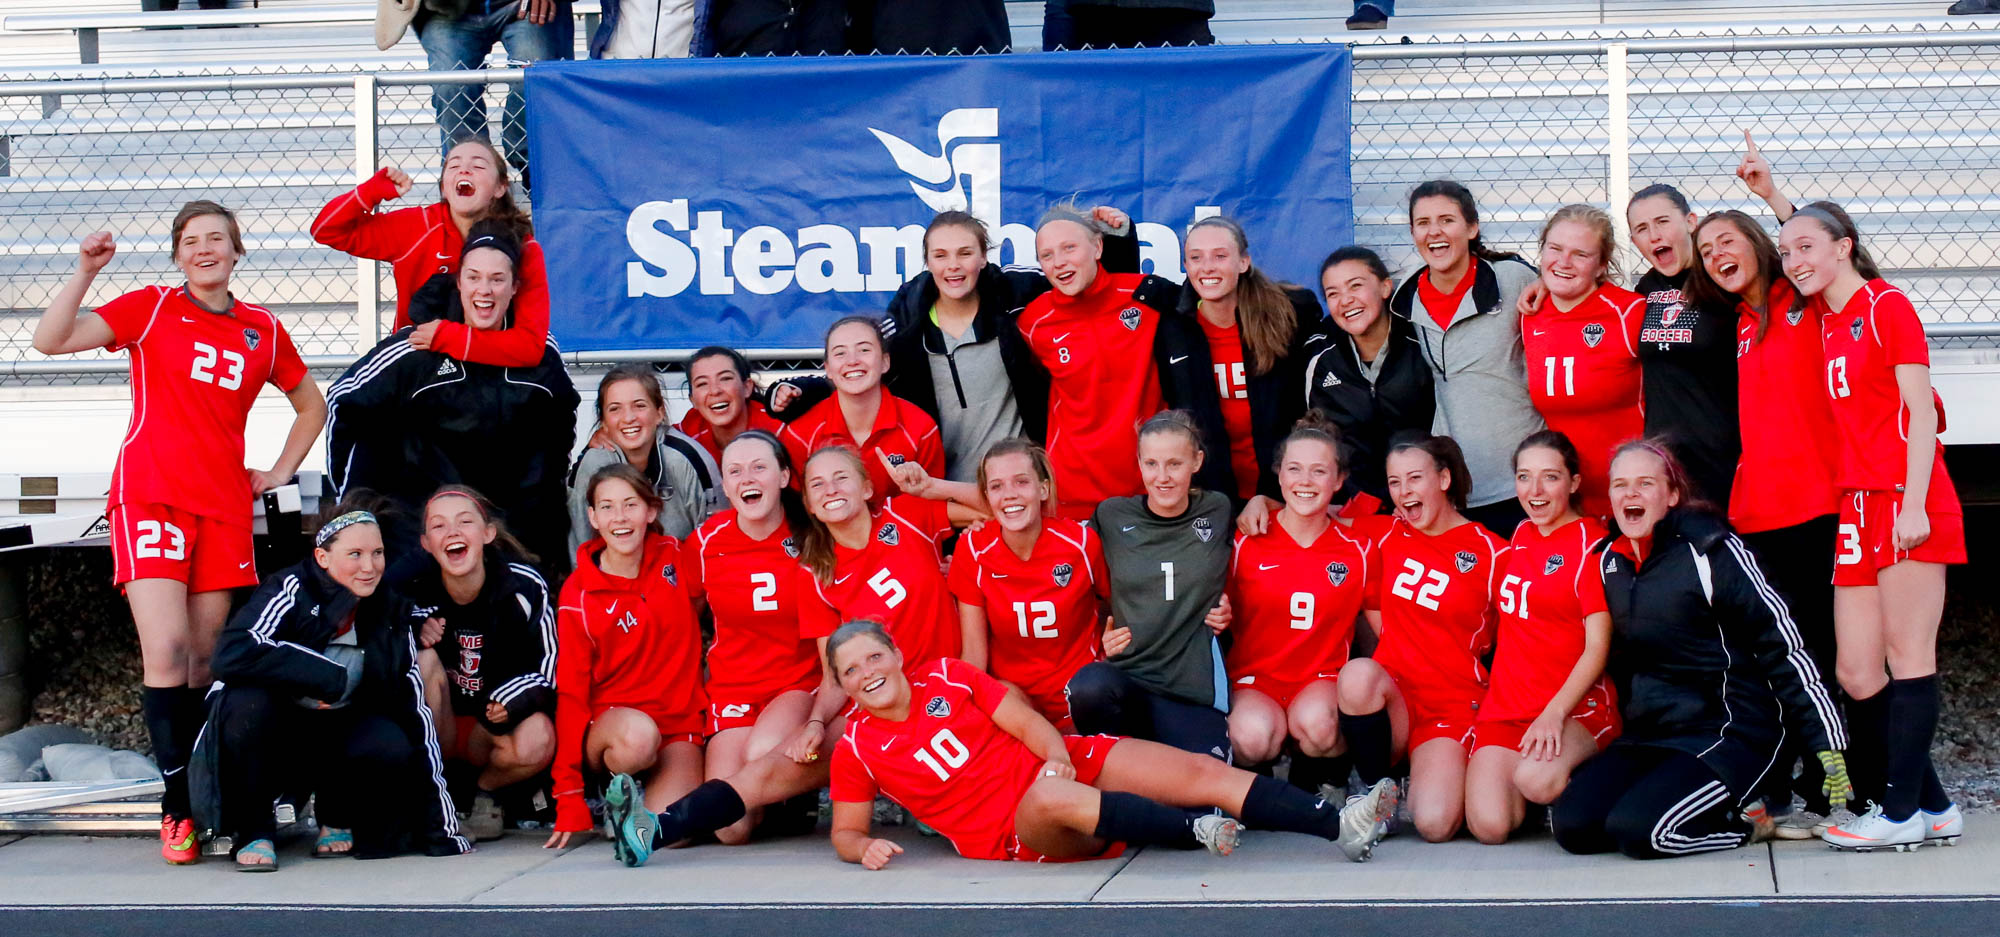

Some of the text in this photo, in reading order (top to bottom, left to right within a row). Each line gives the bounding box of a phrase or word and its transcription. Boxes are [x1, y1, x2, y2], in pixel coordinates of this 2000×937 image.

[1058, 347, 1071, 364] 8
[1640, 328, 1692, 343] SOCCER
[1737, 338, 1751, 358] 21
[190, 341, 245, 391] 23
[1214, 362, 1248, 399] 15
[1545, 356, 1575, 396] 11
[1827, 356, 1851, 400] 13
[136, 520, 185, 560] 23
[750, 572, 778, 611] 2
[866, 567, 907, 609] 5
[1160, 561, 1175, 601] 1
[1391, 557, 1450, 611] 22
[1500, 573, 1532, 620] 51
[616, 610, 638, 633] 14
[1012, 600, 1059, 638] 12
[1289, 591, 1315, 630] 9
[912, 728, 970, 782] 10
